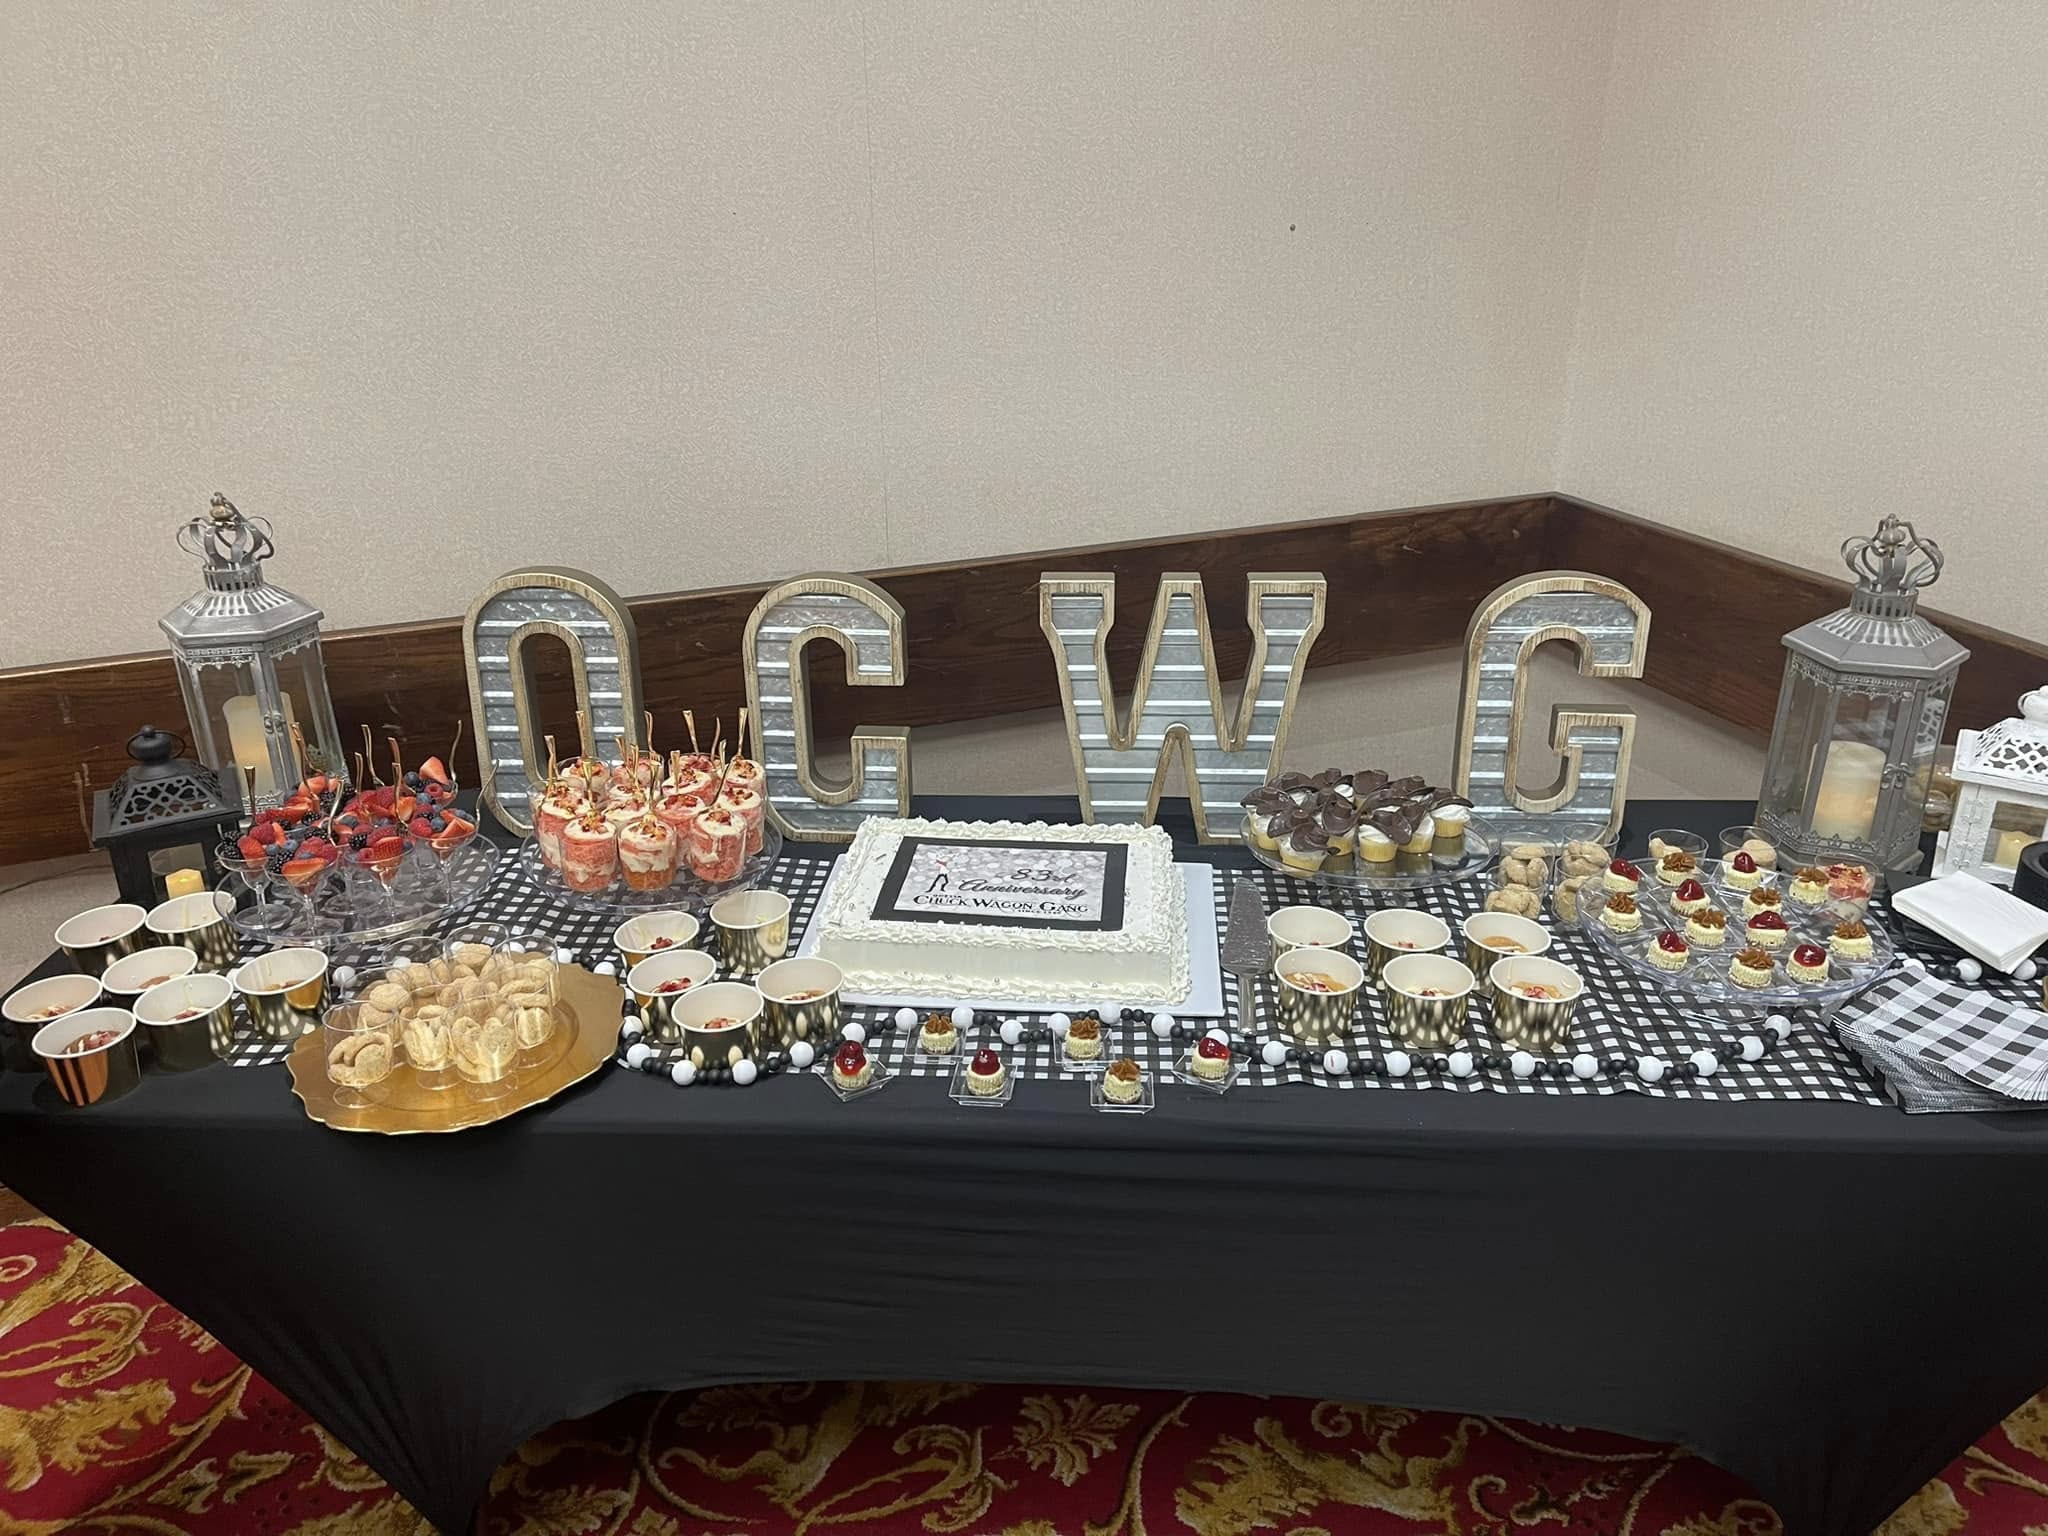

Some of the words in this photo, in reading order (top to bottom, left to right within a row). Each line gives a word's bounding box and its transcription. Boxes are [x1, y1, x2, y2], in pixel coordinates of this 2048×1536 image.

[957, 878, 1088, 900] Anniversary
[913, 894, 968, 907] CHUCK
[972, 897, 1034, 911] WAGON
[1039, 901, 1089, 915] GANG
